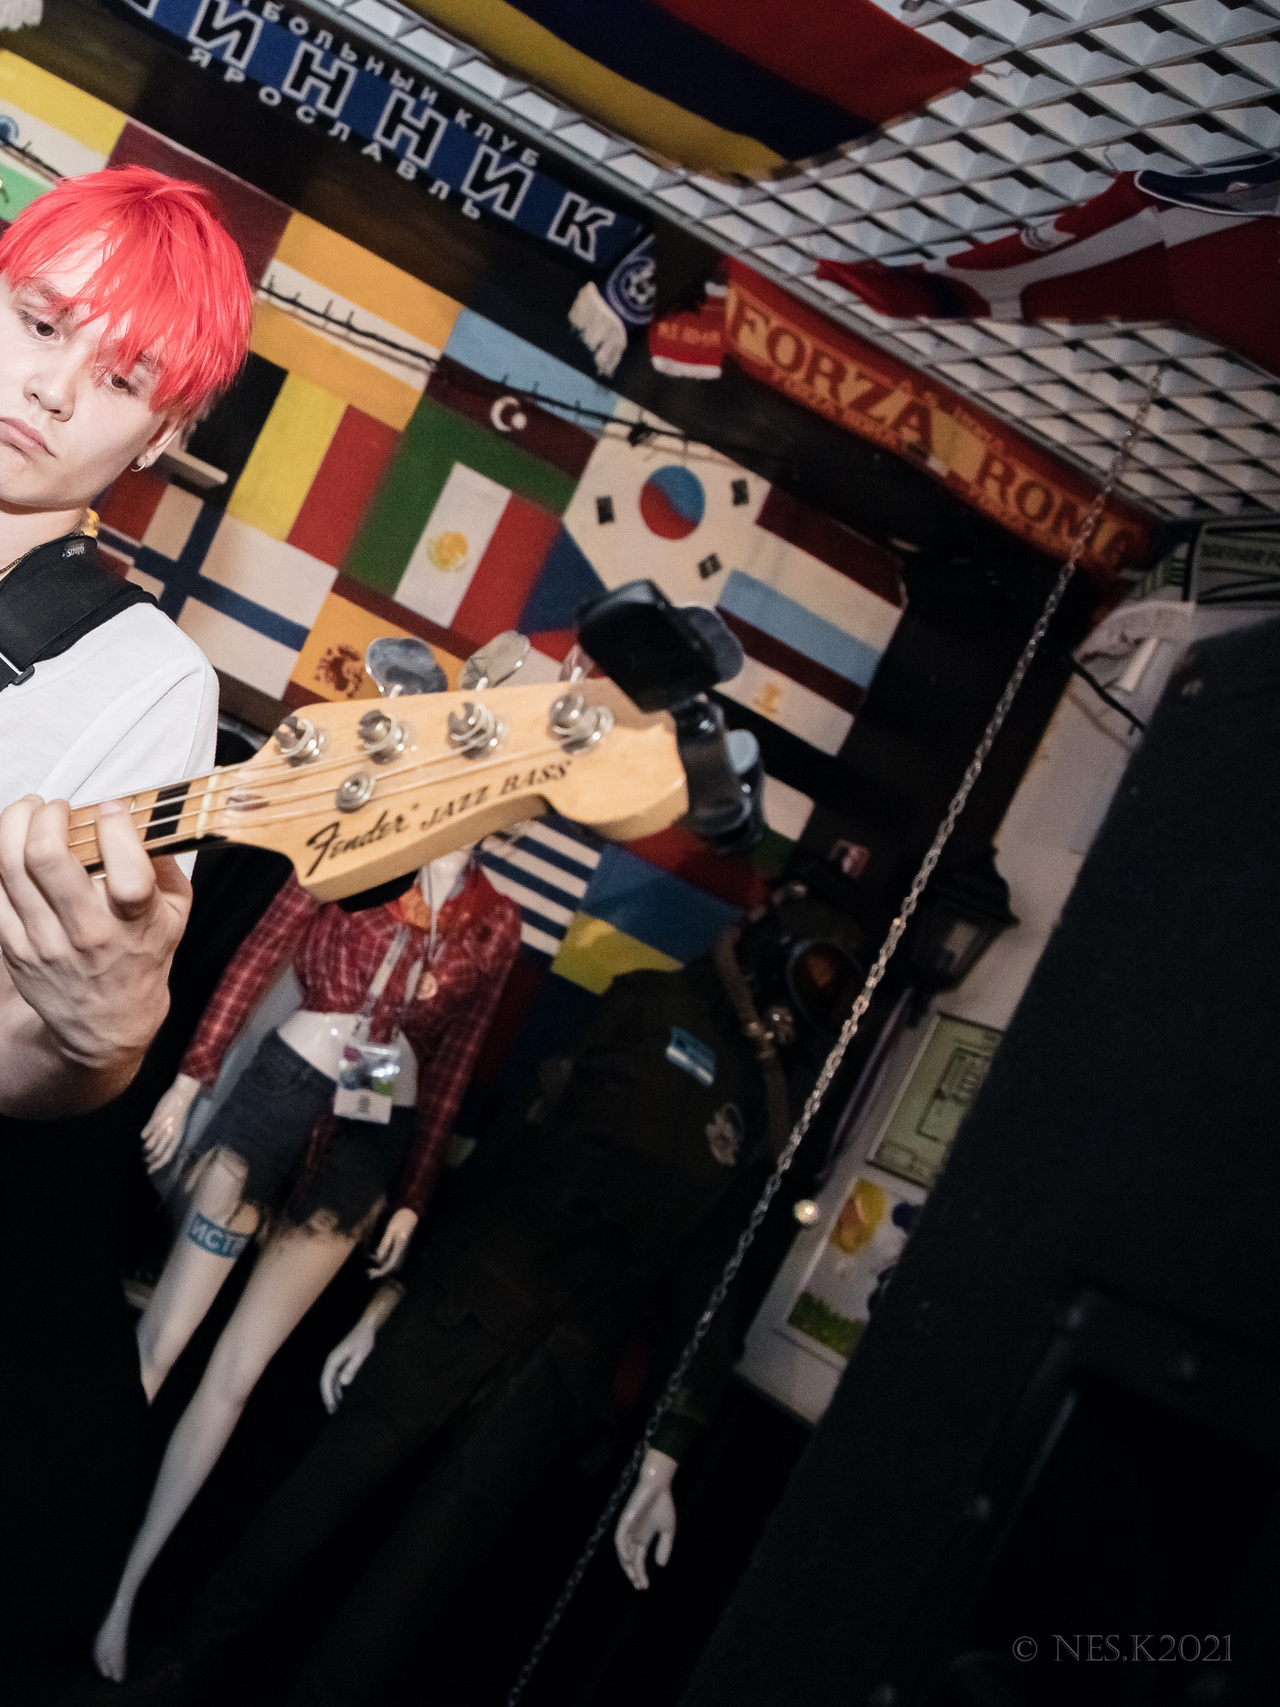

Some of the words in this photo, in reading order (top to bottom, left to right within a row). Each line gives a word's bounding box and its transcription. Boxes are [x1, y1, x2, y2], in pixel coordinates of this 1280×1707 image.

[122, 0, 617, 262] ИННИК
[188, 46, 481, 220] ЯРОСЛАВЛЬ
[453, 108, 540, 167] КЛУБ
[728, 298, 932, 458] FORZA
[306, 809, 410, 877] Fender
[420, 785, 489, 831] JAZZ
[500, 763, 568, 795] BASS
